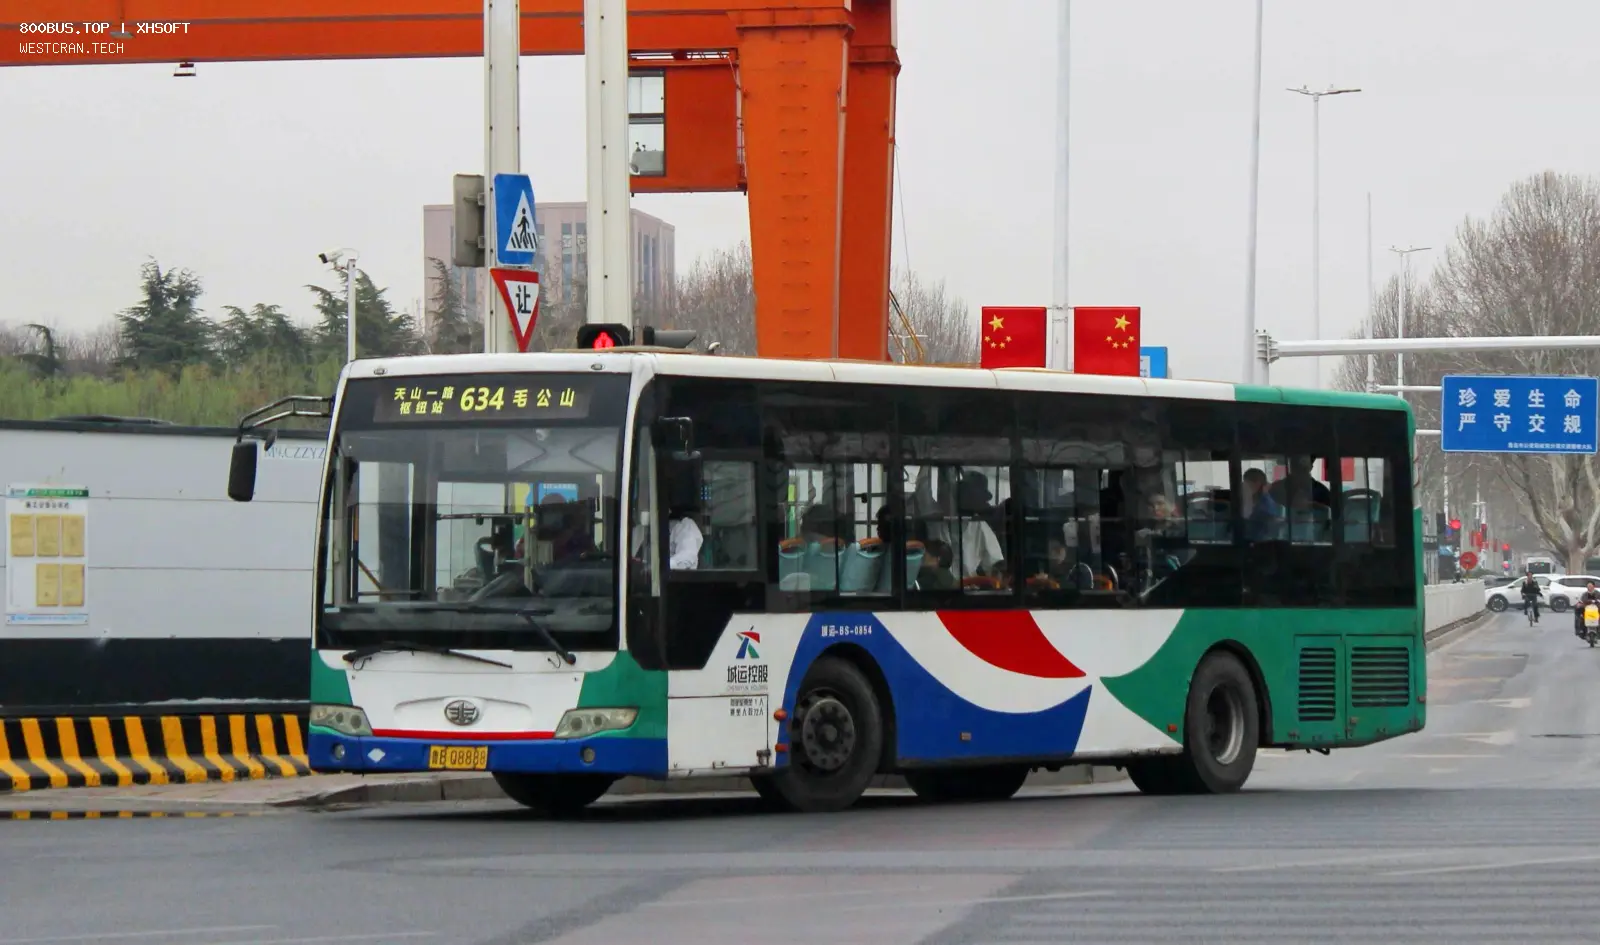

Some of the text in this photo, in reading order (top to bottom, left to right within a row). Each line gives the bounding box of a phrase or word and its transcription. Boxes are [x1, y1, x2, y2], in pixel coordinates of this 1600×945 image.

[515, 284, 532, 314] 让
[394, 386, 455, 401] 天山一路
[460, 387, 505, 411] 634
[512, 388, 576, 408] 毛公山
[1458, 387, 1582, 409] 珍爱生命
[400, 401, 444, 415] 枢纽站
[1458, 413, 1582, 434] 严守交规
[727, 664, 768, 684] 城运控股
